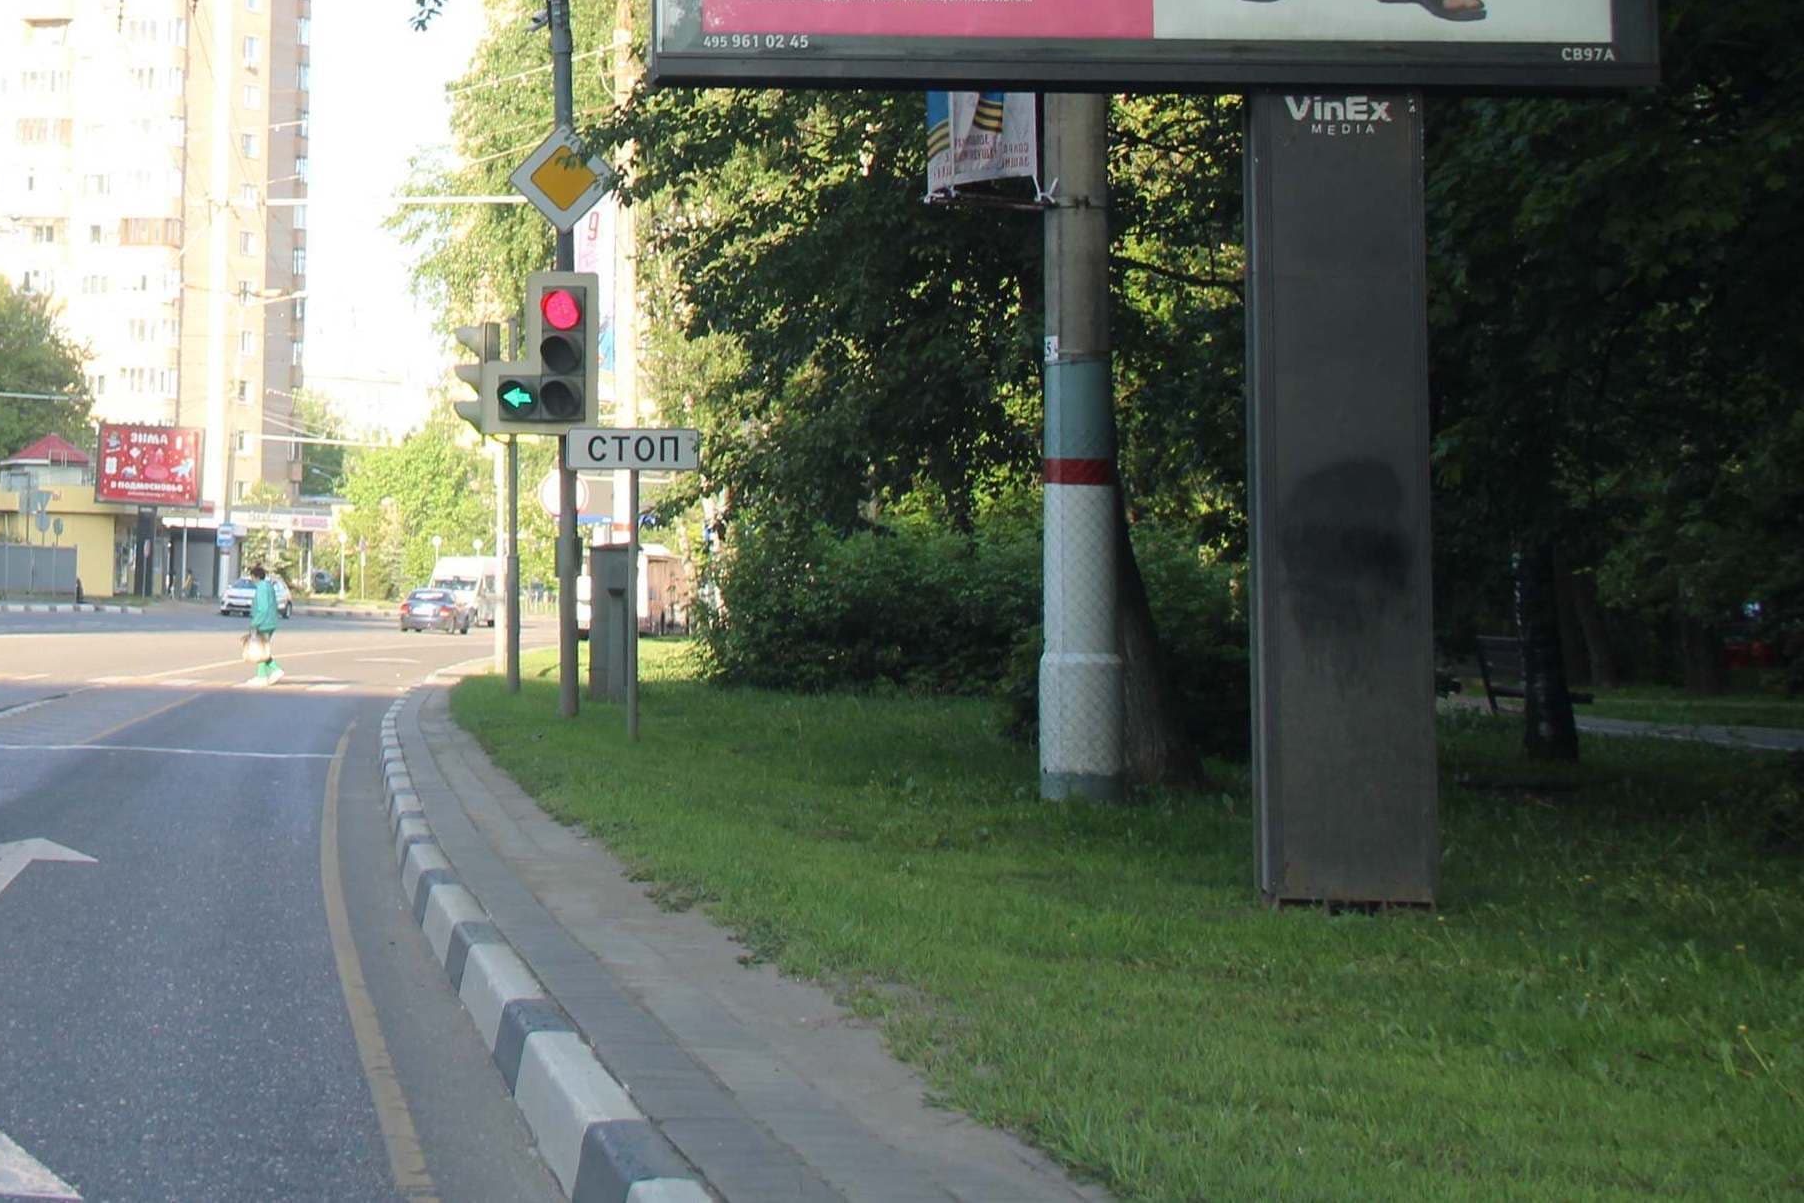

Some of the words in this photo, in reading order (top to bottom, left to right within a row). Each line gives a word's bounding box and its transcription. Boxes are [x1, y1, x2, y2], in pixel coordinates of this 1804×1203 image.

[703, 35, 728, 48] 495
[732, 34, 758, 48] 961
[766, 34, 785, 48] 02
[789, 34, 809, 48] 45
[1285, 96, 1392, 122] VinEx
[1311, 124, 1375, 136] MEDIA
[130, 432, 168, 445] ЗИМА
[587, 435, 679, 462] СТОП
